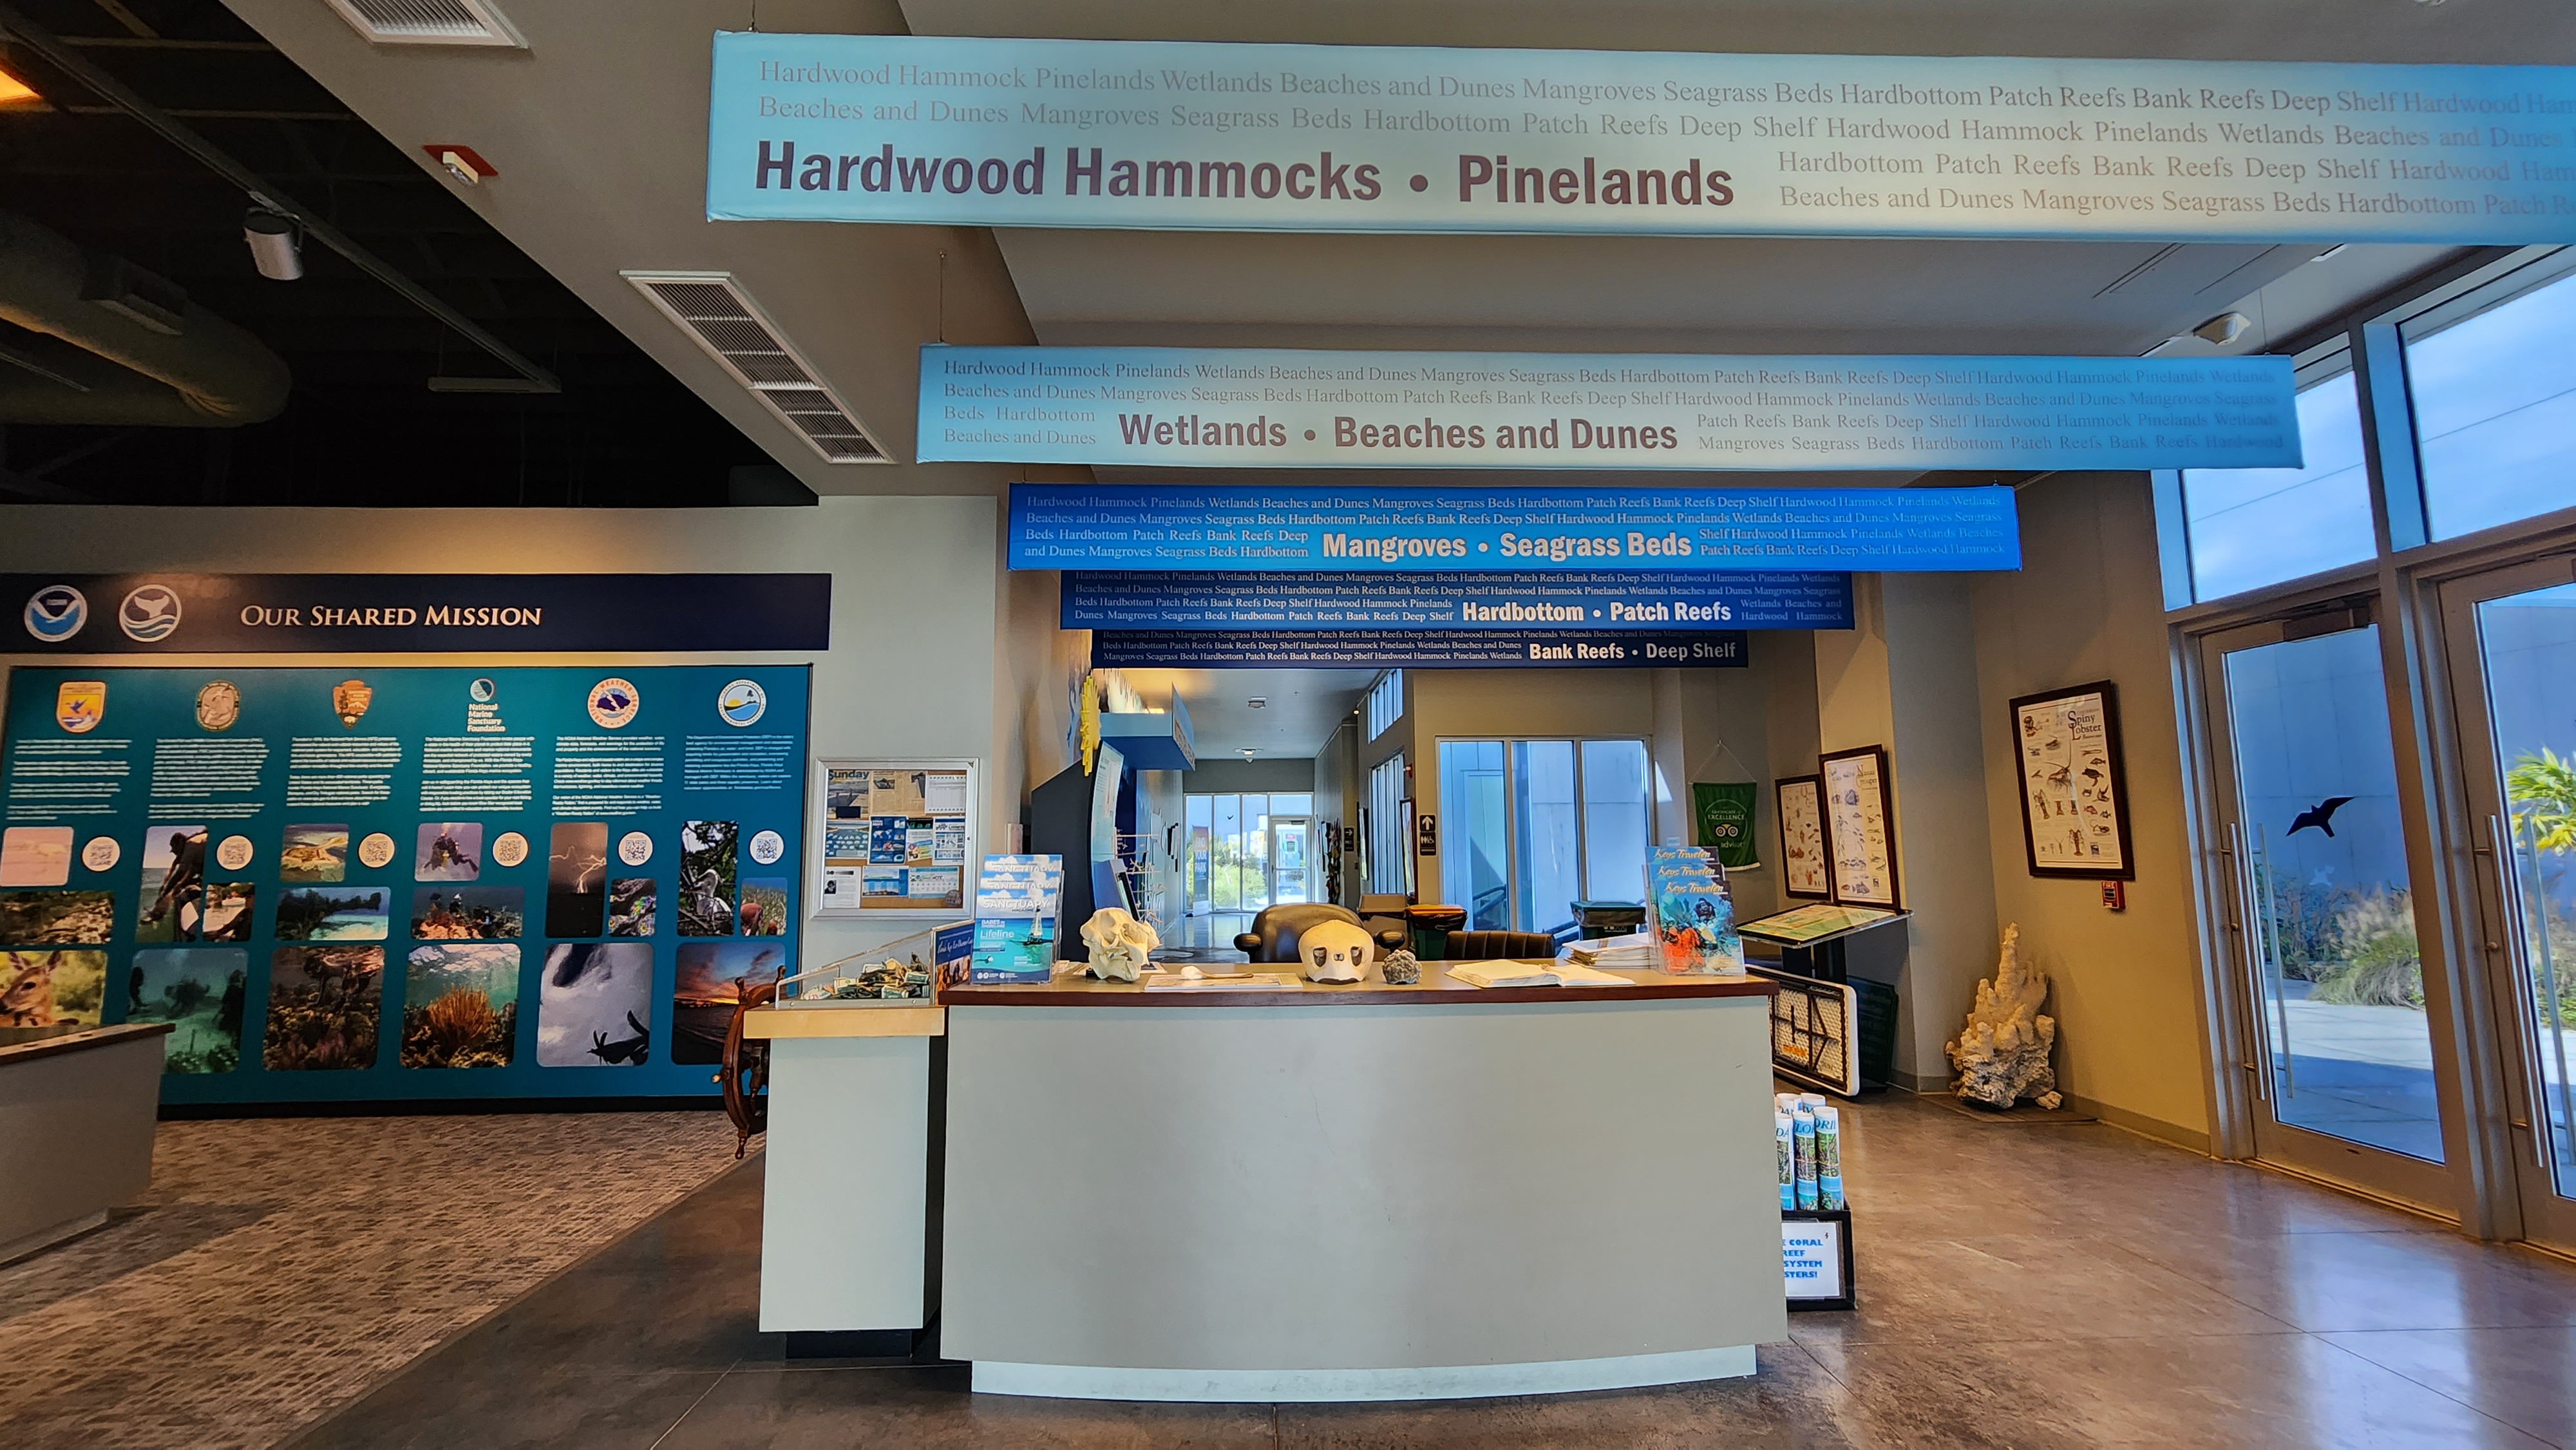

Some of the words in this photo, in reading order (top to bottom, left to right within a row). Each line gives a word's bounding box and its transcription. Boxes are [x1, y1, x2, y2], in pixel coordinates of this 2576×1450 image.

[762, 62, 889, 84] Hardwood
[900, 66, 1025, 87] Hammock
[1037, 68, 1154, 89] Pinelands
[1162, 70, 1271, 92] Wetlands
[1282, 73, 1380, 94] Beaches
[1389, 75, 1430, 95] and
[1441, 77, 1515, 97] Dunes
[1524, 79, 1655, 104] Mangroves
[1664, 81, 1766, 107] Seagrass
[1777, 83, 1832, 103] Beds
[1842, 84, 1980, 105] Hardbottom
[1991, 86, 2051, 106] Patch
[2061, 87, 2125, 107] Reefs
[2134, 88, 2190, 108] Bank
[2201, 89, 2264, 109] Reefs
[2273, 90, 2330, 116] Deep
[2338, 91, 2394, 111] Shelf
[2404, 93, 2519, 113] Hardwood
[757, 141, 1044, 194] Hardwood
[1066, 148, 1381, 200] Hammocks
[1460, 155, 1733, 205] Pinelands
[1780, 152, 1922, 173] Hardbottom
[1937, 154, 2000, 174] Patch
[2014, 155, 2080, 175] Reefs
[2094, 156, 2152, 175] Bank
[2168, 156, 2233, 176] Reefs
[2246, 158, 2305, 184] Deep
[2318, 159, 2376, 178] Shelf
[2391, 160, 2508, 180] Hardwood
[1782, 186, 1879, 207] Beaches
[1889, 188, 1929, 207] and
[1940, 189, 2013, 209] Dunes
[2023, 189, 2154, 215] Mangroves
[2163, 191, 2264, 216] Seagrass
[2275, 192, 2330, 212] Beds
[2338, 193, 2474, 212] Hardbottom
[2485, 194, 2544, 214] Patch
[945, 361, 1025, 375] Hardwood
[1032, 362, 1108, 376] Hammock
[1117, 364, 1189, 377] Pinelands
[1196, 365, 1264, 378] Wetlands
[1271, 366, 1332, 379] Beaches
[1338, 367, 1363, 380] and
[1370, 368, 1416, 381] Dunes
[1422, 368, 1504, 384] Mangroves
[1510, 369, 1575, 386] Seagrass
[1580, 370, 1615, 382] Beds
[1622, 370, 1709, 382] Hardbottom
[1716, 371, 1754, 382] Patch
[1760, 371, 1800, 383] Reefs
[1806, 371, 1841, 383] Bank
[1848, 372, 1888, 384] Reefs
[1893, 372, 1930, 387] Deep
[1936, 371, 1974, 383] Shelf
[1978, 372, 2052, 383] Hardwood
[2058, 371, 2130, 383] Hammock
[2137, 370, 2203, 382] Pinelands
[2210, 368, 2275, 382] Wetlands
[1119, 415, 1286, 446] Wetlands
[1335, 417, 1484, 447] Beaches
[1497, 419, 1558, 448] and
[1571, 419, 1677, 449] Dunes
[1026, 529, 1054, 539] Beds
[1060, 529, 1127, 540] Hardbottom
[1133, 530, 1164, 540] Patch
[1170, 530, 1201, 540] Reefs
[1208, 530, 1236, 540] Bank
[1242, 530, 1273, 540] Reefs
[1280, 531, 1307, 543] Deep
[1025, 545, 1045, 556] and
[1050, 546, 1085, 556] Dunes
[1090, 546, 1151, 559] Mangroves
[1156, 547, 1206, 559] Seagrass
[1209, 547, 1236, 556] Beds
[1240, 547, 1308, 556] Hardbottom
[1324, 534, 1466, 562] Mangroves
[1501, 533, 1620, 561] Seagrass
[1627, 531, 1691, 556] Beds
[1075, 610, 1103, 619] Dunes
[1108, 611, 1157, 621] Mangroves
[1162, 612, 1200, 621] Seagrass
[1289, 612, 1312, 620] Patch
[1318, 612, 1342, 620] Reefs
[1347, 612, 1369, 620] Bank
[1374, 612, 1398, 620] Reefs
[1403, 612, 1425, 623] Deep
[1463, 603, 1584, 621] Hardbottom
[1611, 602, 1669, 621] Patch
[1675, 602, 1731, 620] Reefs
[1104, 653, 1144, 661] Mangroves
[1146, 653, 1177, 661] Seagrass
[1530, 644, 1573, 659] Bank
[1578, 643, 1624, 658] Reefs
[1647, 643, 1687, 661] Deep
[1694, 643, 1735, 657] Shelf
[600, 680, 632, 692] WEATHER
[2068, 710, 2095, 728] Spiny
[2068, 722, 2101, 740] Lobster
[828, 769, 869, 780] Sunday
[1654, 848, 1676, 861] Keys
[1658, 865, 1680, 878] Keys
[1664, 881, 1687, 895] Keys
[983, 899, 1050, 909] SANCTUARY
[980, 929, 1014, 938] Lifeline
